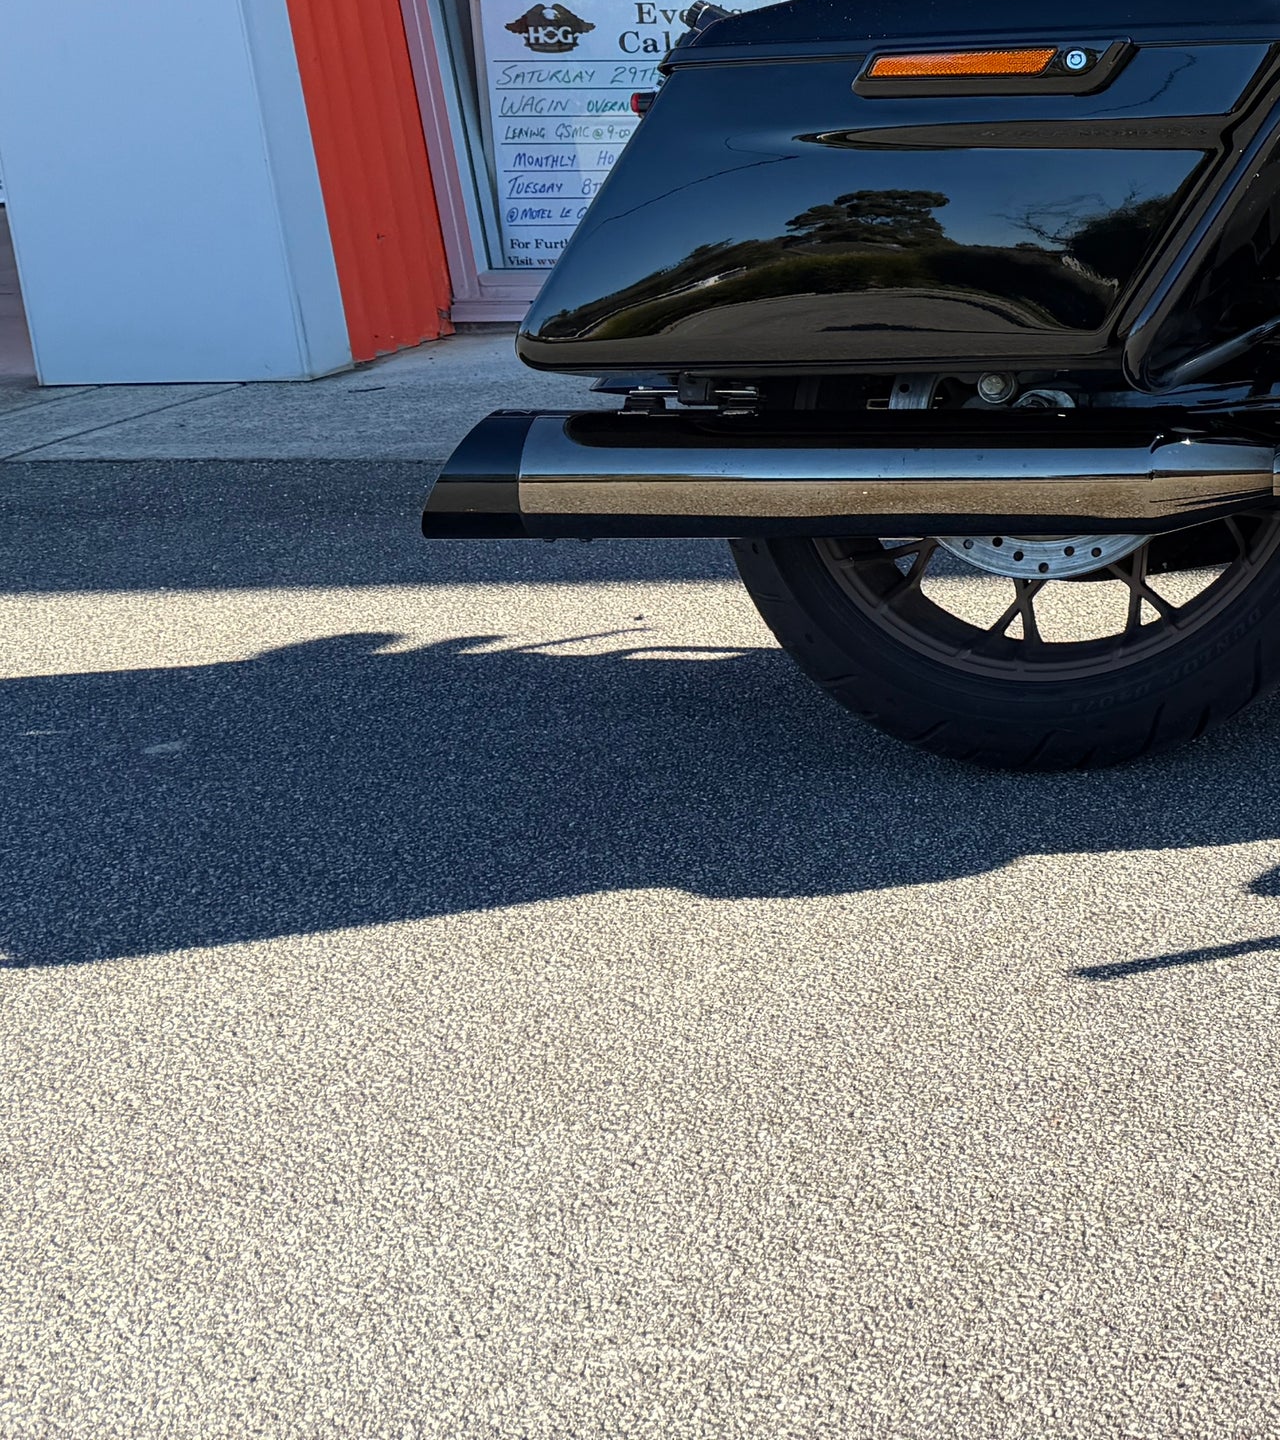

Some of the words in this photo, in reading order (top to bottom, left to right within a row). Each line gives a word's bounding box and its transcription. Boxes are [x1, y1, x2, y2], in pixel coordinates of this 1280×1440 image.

[528, 26, 573, 44] HOG
[496, 64, 596, 86] SATURDAY
[505, 125, 546, 140] LEAVING
[512, 152, 576, 168] MONTHLY
[508, 174, 563, 197] TUESDAY
[509, 238, 531, 249] For
[508, 256, 534, 266] Visit
